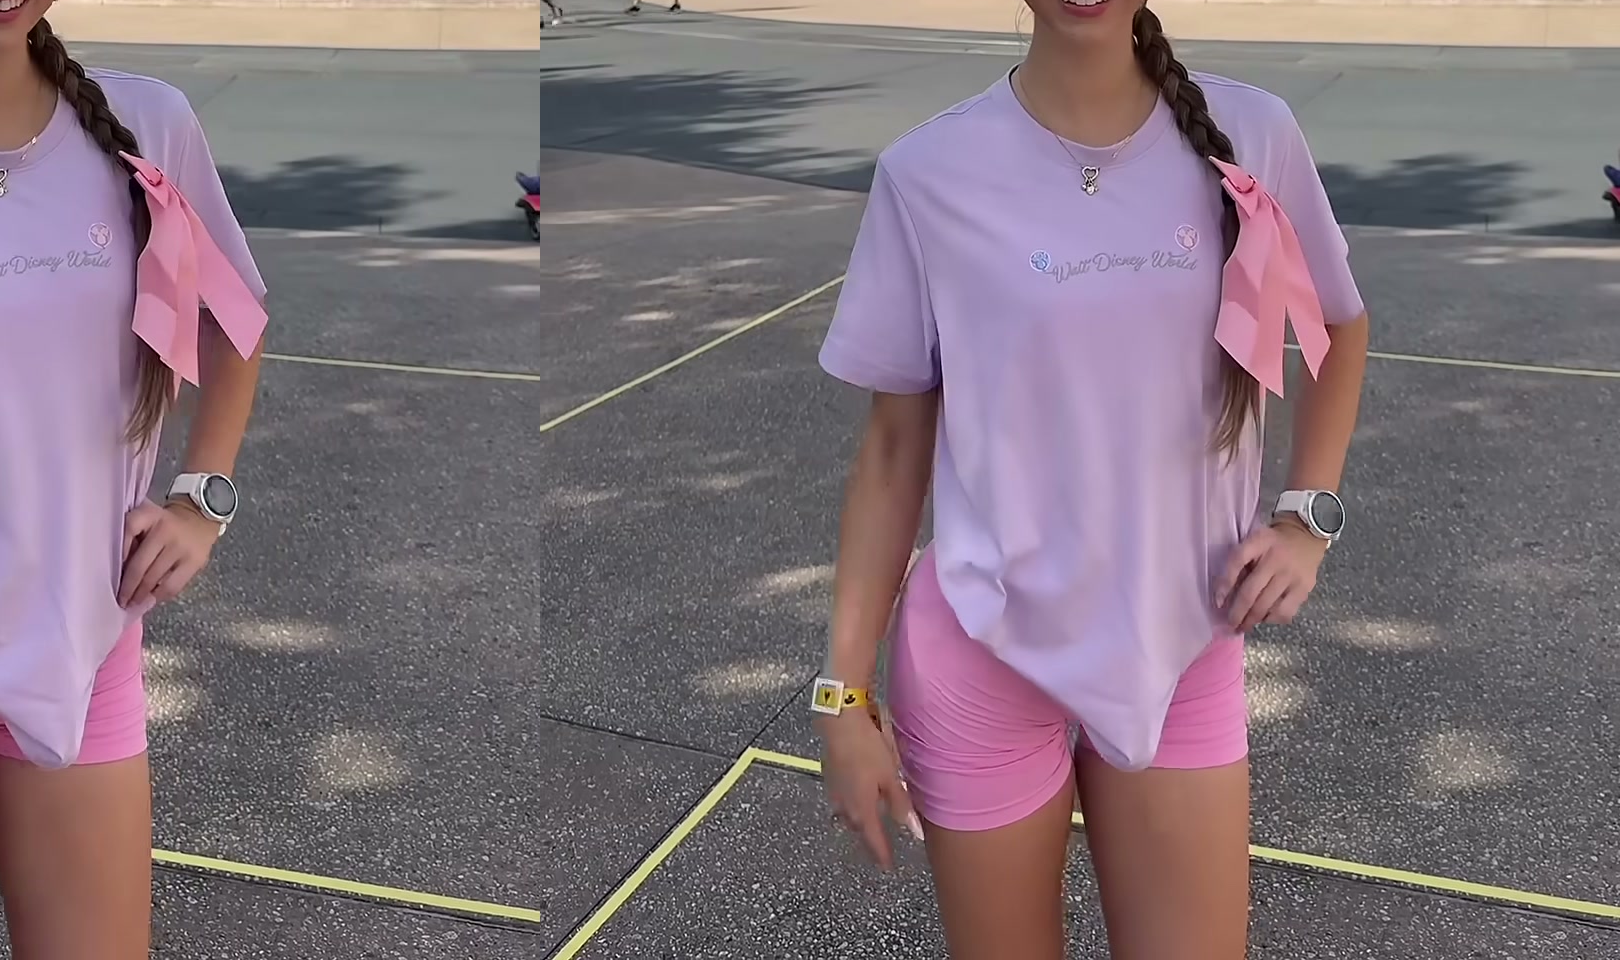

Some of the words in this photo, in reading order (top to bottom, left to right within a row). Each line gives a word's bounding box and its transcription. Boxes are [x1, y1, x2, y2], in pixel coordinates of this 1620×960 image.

[9, 255, 64, 273] Disney
[67, 250, 112, 268] World
[1052, 259, 1092, 284] Walt
[1092, 252, 1148, 272] Disney
[1151, 250, 1198, 271] World
